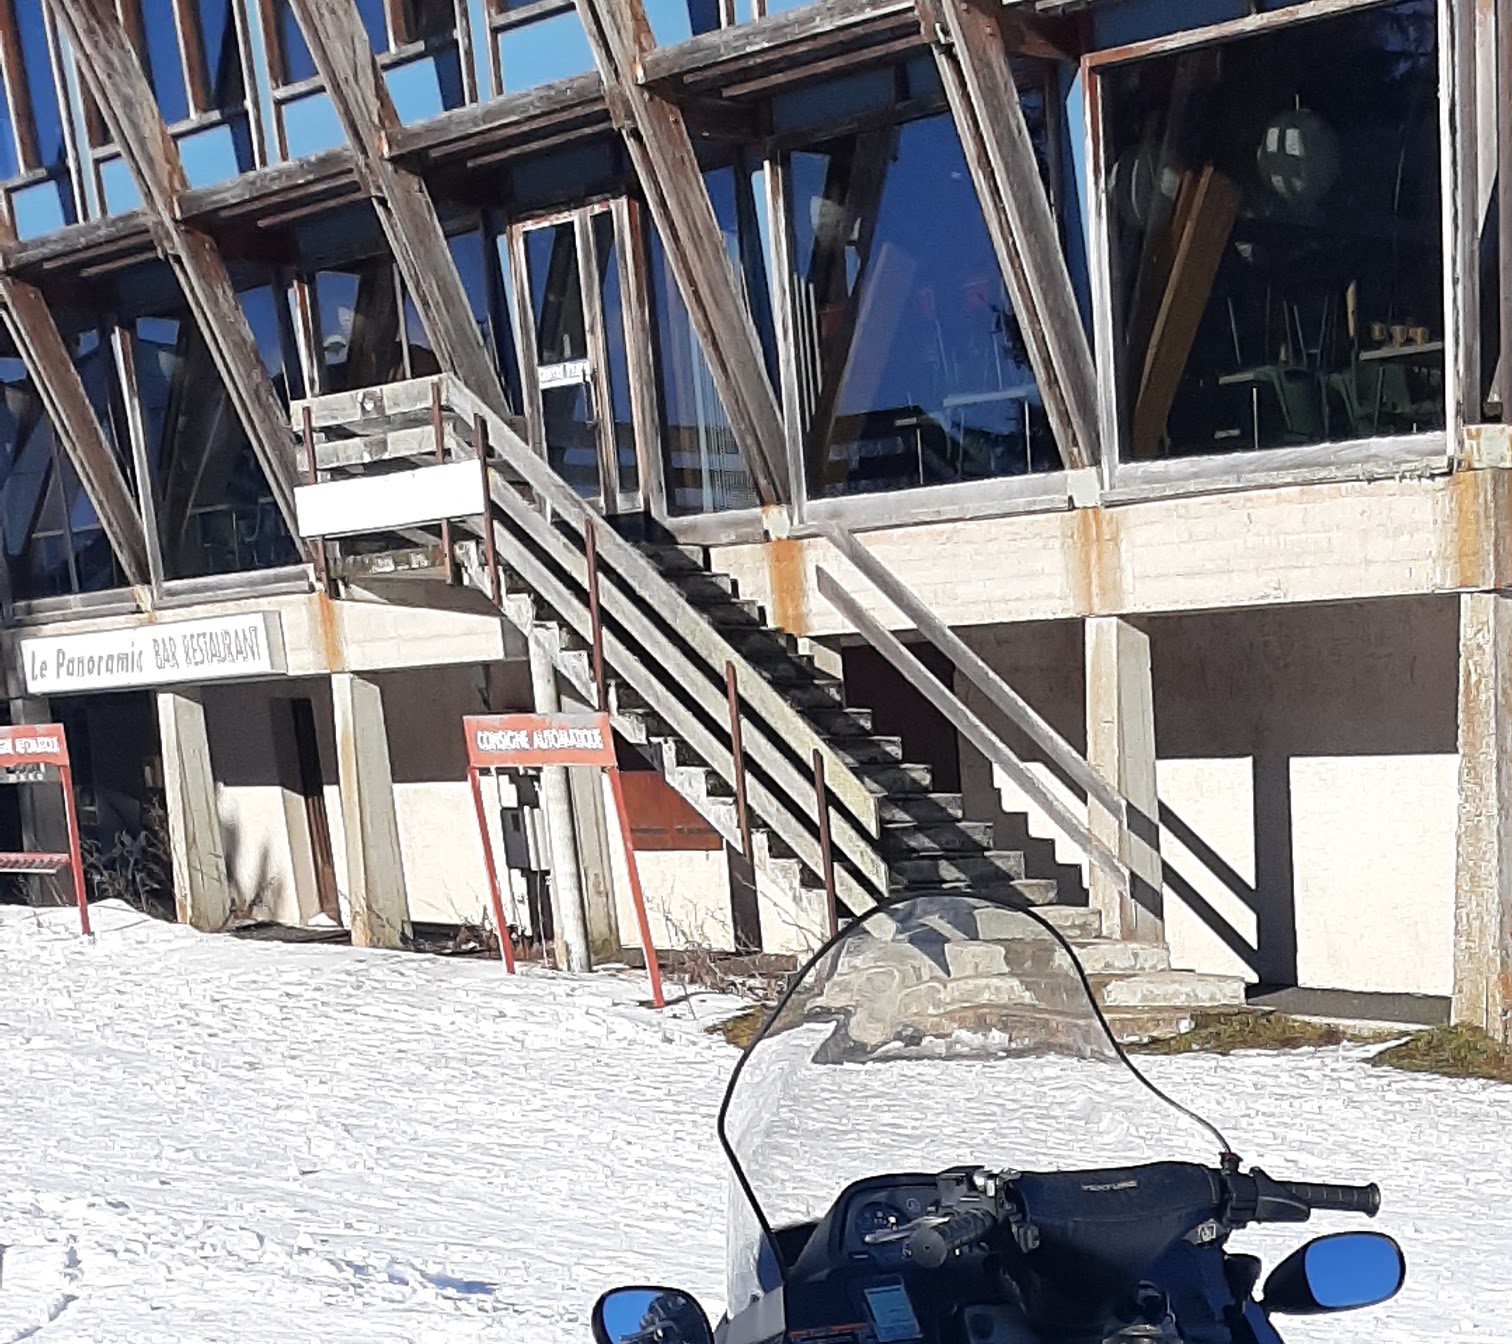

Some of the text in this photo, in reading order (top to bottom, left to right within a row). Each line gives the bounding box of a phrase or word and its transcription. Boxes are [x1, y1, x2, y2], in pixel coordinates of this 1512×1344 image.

[31, 626, 261, 681] Le Panoramic BAR RESTAURANT
